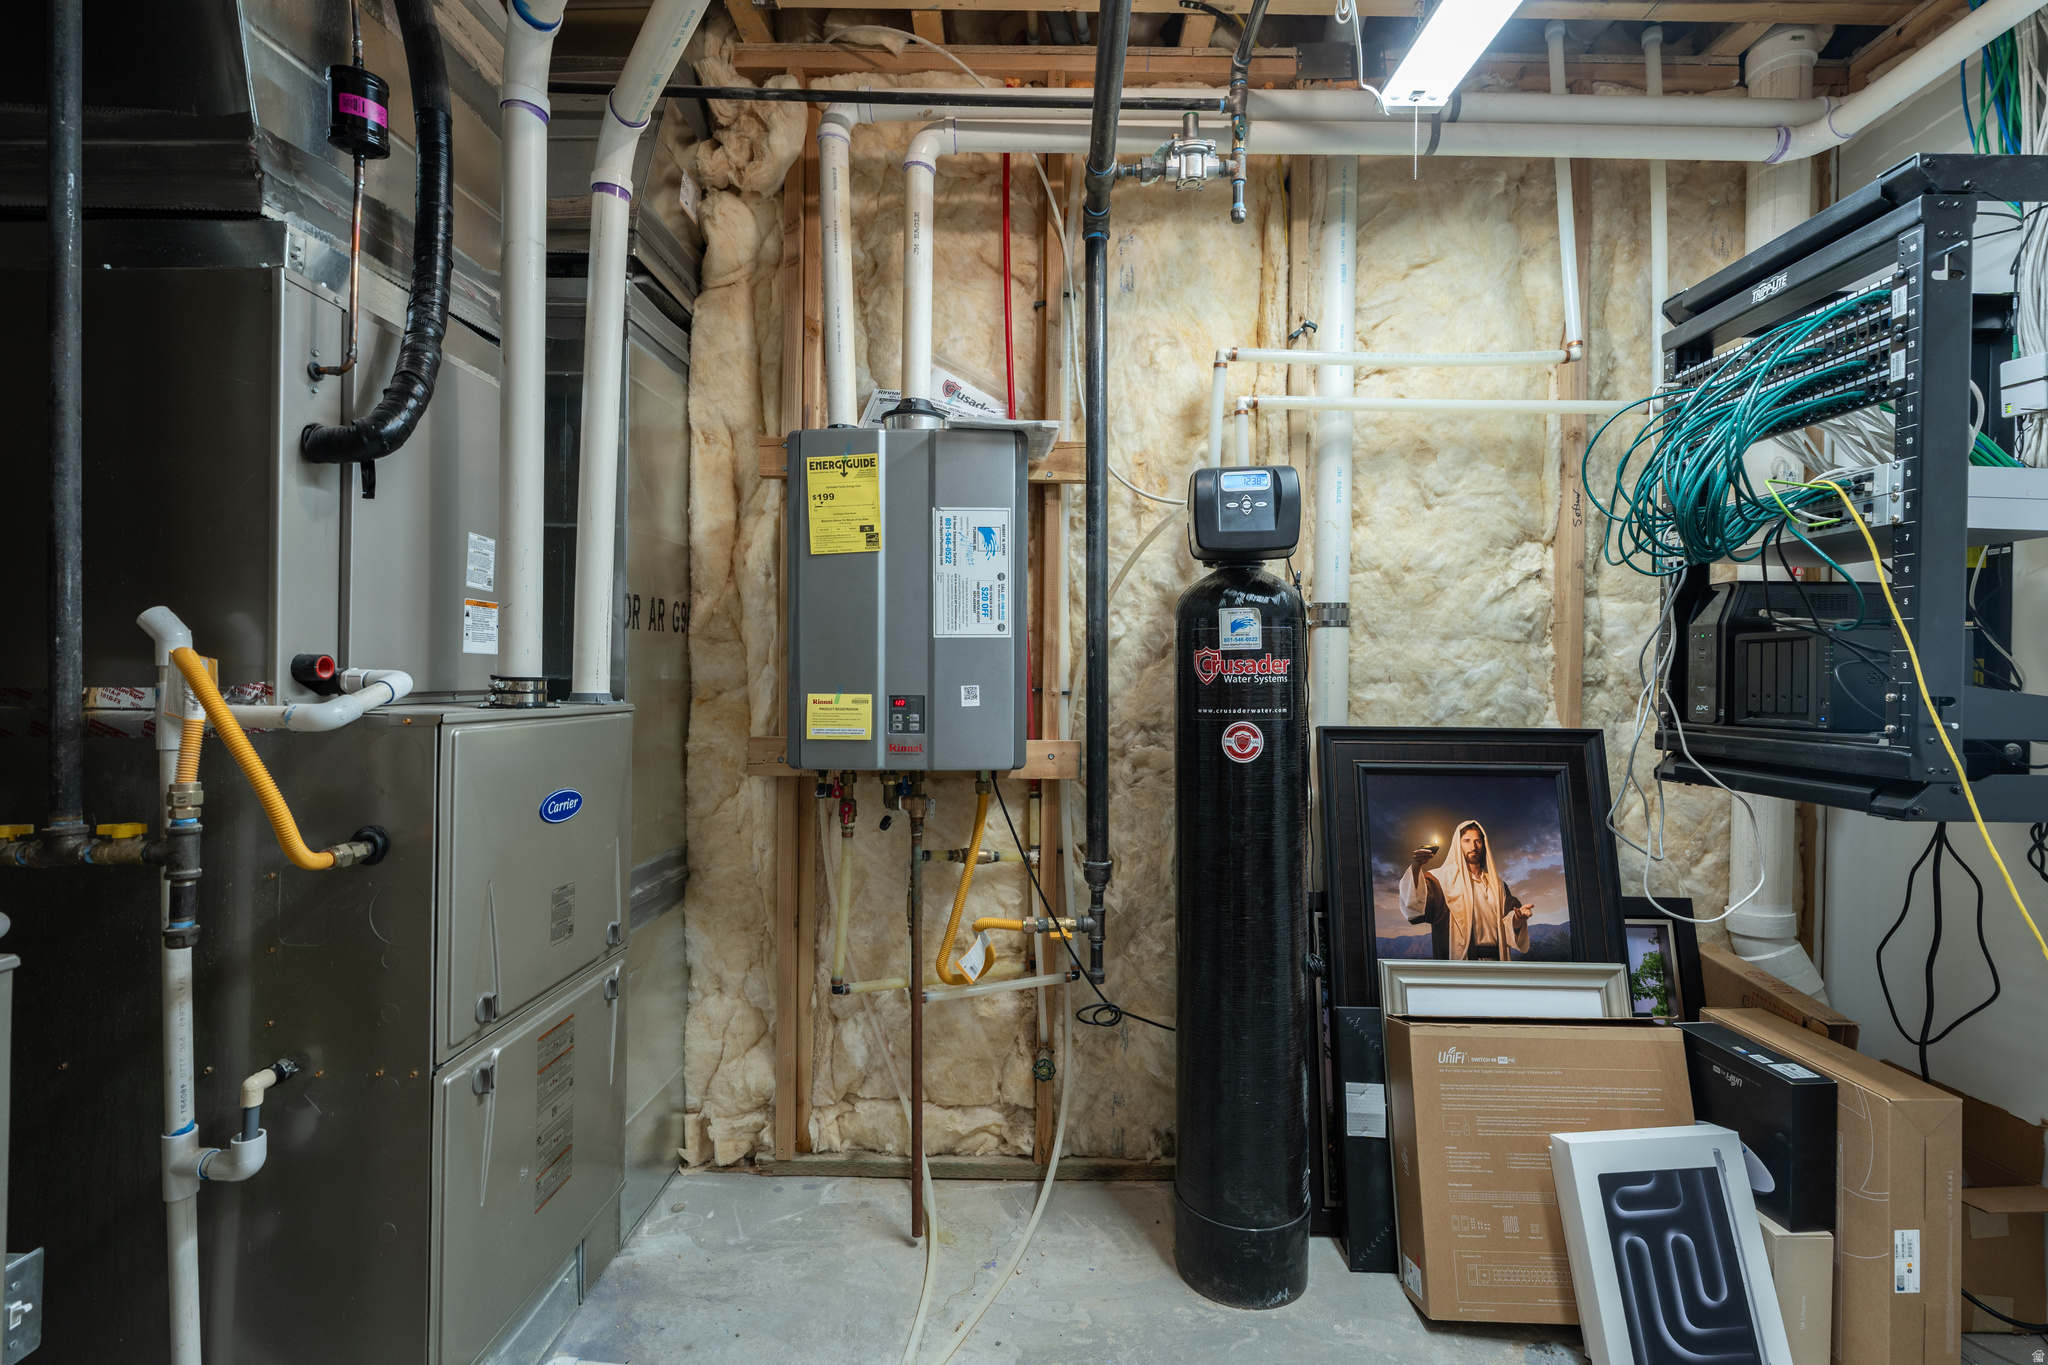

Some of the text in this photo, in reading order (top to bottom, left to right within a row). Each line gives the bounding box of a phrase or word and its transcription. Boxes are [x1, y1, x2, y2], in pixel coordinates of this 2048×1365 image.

[914, 244, 920, 256] JM
[1910, 244, 1917, 252] 16
[1909, 276, 1916, 284] 15
[1909, 309, 1916, 317] 14
[1908, 340, 1915, 348] 13
[1906, 437, 1914, 445] 10
[1336, 466, 1342, 477] JM
[1906, 469, 1911, 477] 9
[1906, 501, 1911, 510] 8
[1905, 533, 1910, 541] 7
[1904, 566, 1910, 574] 6
[1904, 598, 1909, 606] 5
[648, 597, 665, 632] AR
[1199, 653, 1290, 676] Crusader
[1903, 661, 1908, 670] 3
[1224, 675, 1288, 686] Water Systems
[1902, 694, 1907, 702] 2
[889, 744, 922, 752] Rinnai
[548, 798, 578, 814] Carrier
[1438, 1050, 1467, 1064] UniFi
[1726, 1072, 1742, 1087] UniFi
